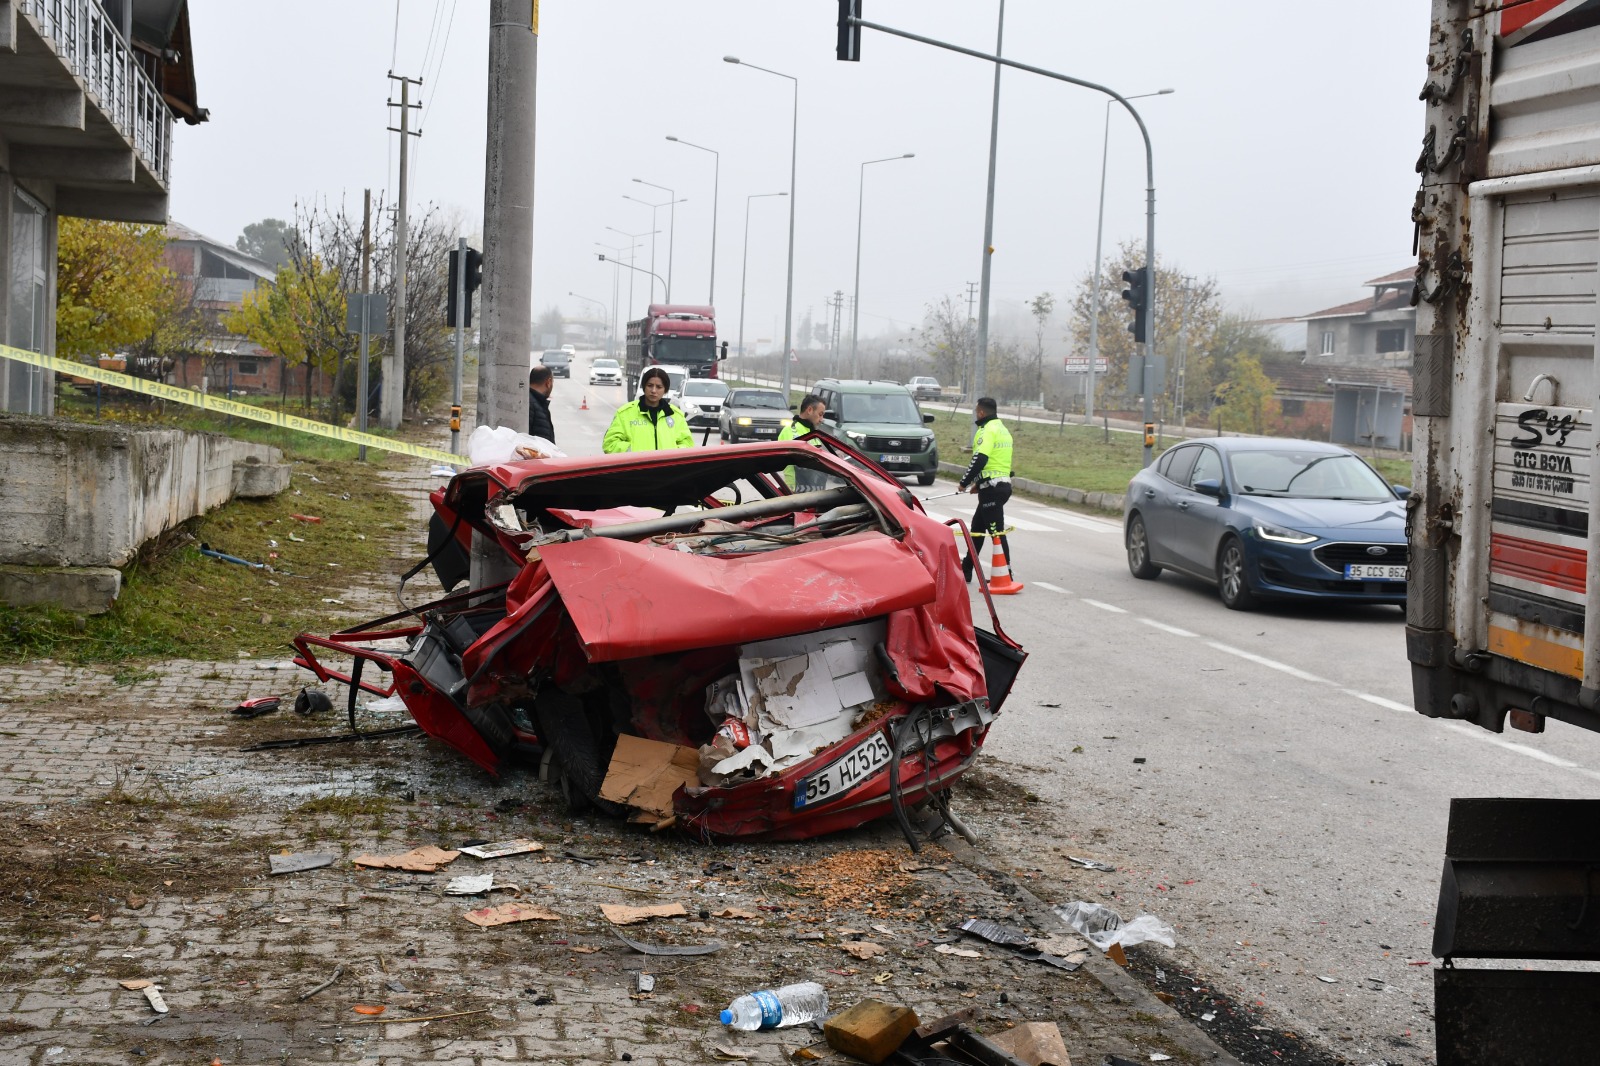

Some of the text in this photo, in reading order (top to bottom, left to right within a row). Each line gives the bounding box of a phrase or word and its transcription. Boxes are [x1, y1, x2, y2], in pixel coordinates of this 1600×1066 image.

[1514, 451, 1572, 473] OTO BOYA
[1351, 565, 1406, 578] 35 CCS 862
[806, 737, 890, 800] 55 HZ525
